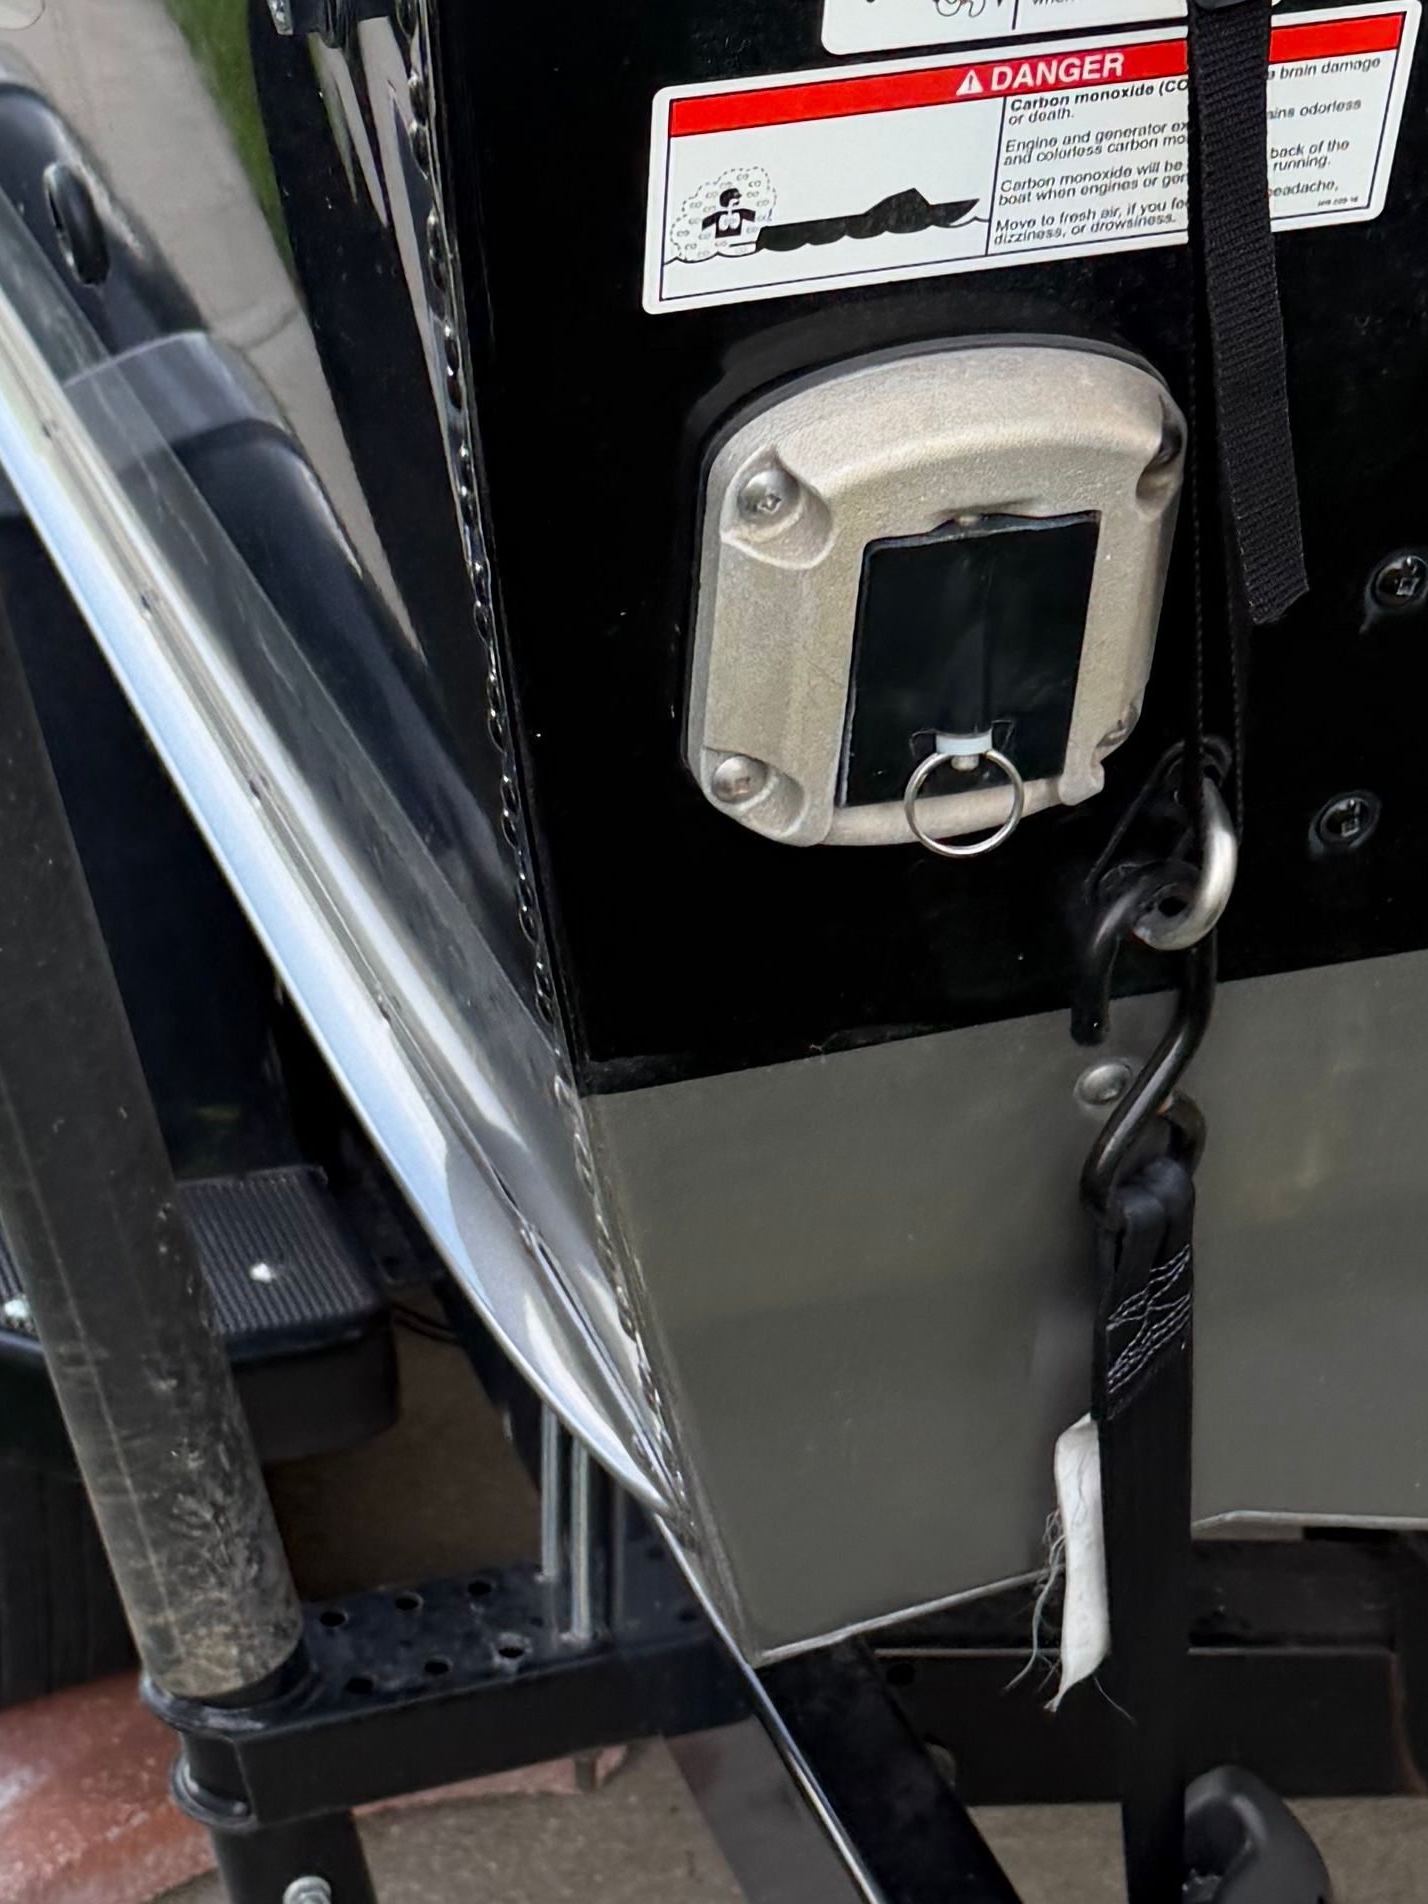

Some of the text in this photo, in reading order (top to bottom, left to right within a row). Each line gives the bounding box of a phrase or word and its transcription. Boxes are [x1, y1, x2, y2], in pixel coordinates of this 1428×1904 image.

[991, 52, 1125, 91] DANGER
[1010, 96, 1069, 112] Carbon
[1074, 84, 1154, 106] monoxide
[1159, 78, 1189, 97] (CO
[1279, 63, 1317, 80] brain
[1321, 56, 1381, 76] damage
[1005, 136, 1058, 157] Engine
[1062, 129, 1091, 144] and
[1095, 122, 1167, 144] generator
[1300, 98, 1362, 117] odorless
[1008, 106, 1074, 126] or death.
[1000, 138, 1350, 193] Carbon monoxide will be back of the
[1003, 151, 1032, 166] and
[1036, 143, 1103, 163] colorless
[1107, 137, 1158, 154] carbon
[998, 190, 1033, 207] boat
[1036, 185, 1076, 202] when
[1080, 178, 1139, 199] engines
[1143, 175, 1159, 189] or
[1273, 154, 1331, 172] running.
[993, 213, 1177, 246] dizziness, or drowsiness.
[995, 217, 1036, 233] Move
[1041, 214, 1055, 227] to
[1059, 206, 1096, 224] fresh
[1100, 202, 1122, 219] air,
[1126, 200, 1136, 216] if
[1140, 198, 1168, 218] you
